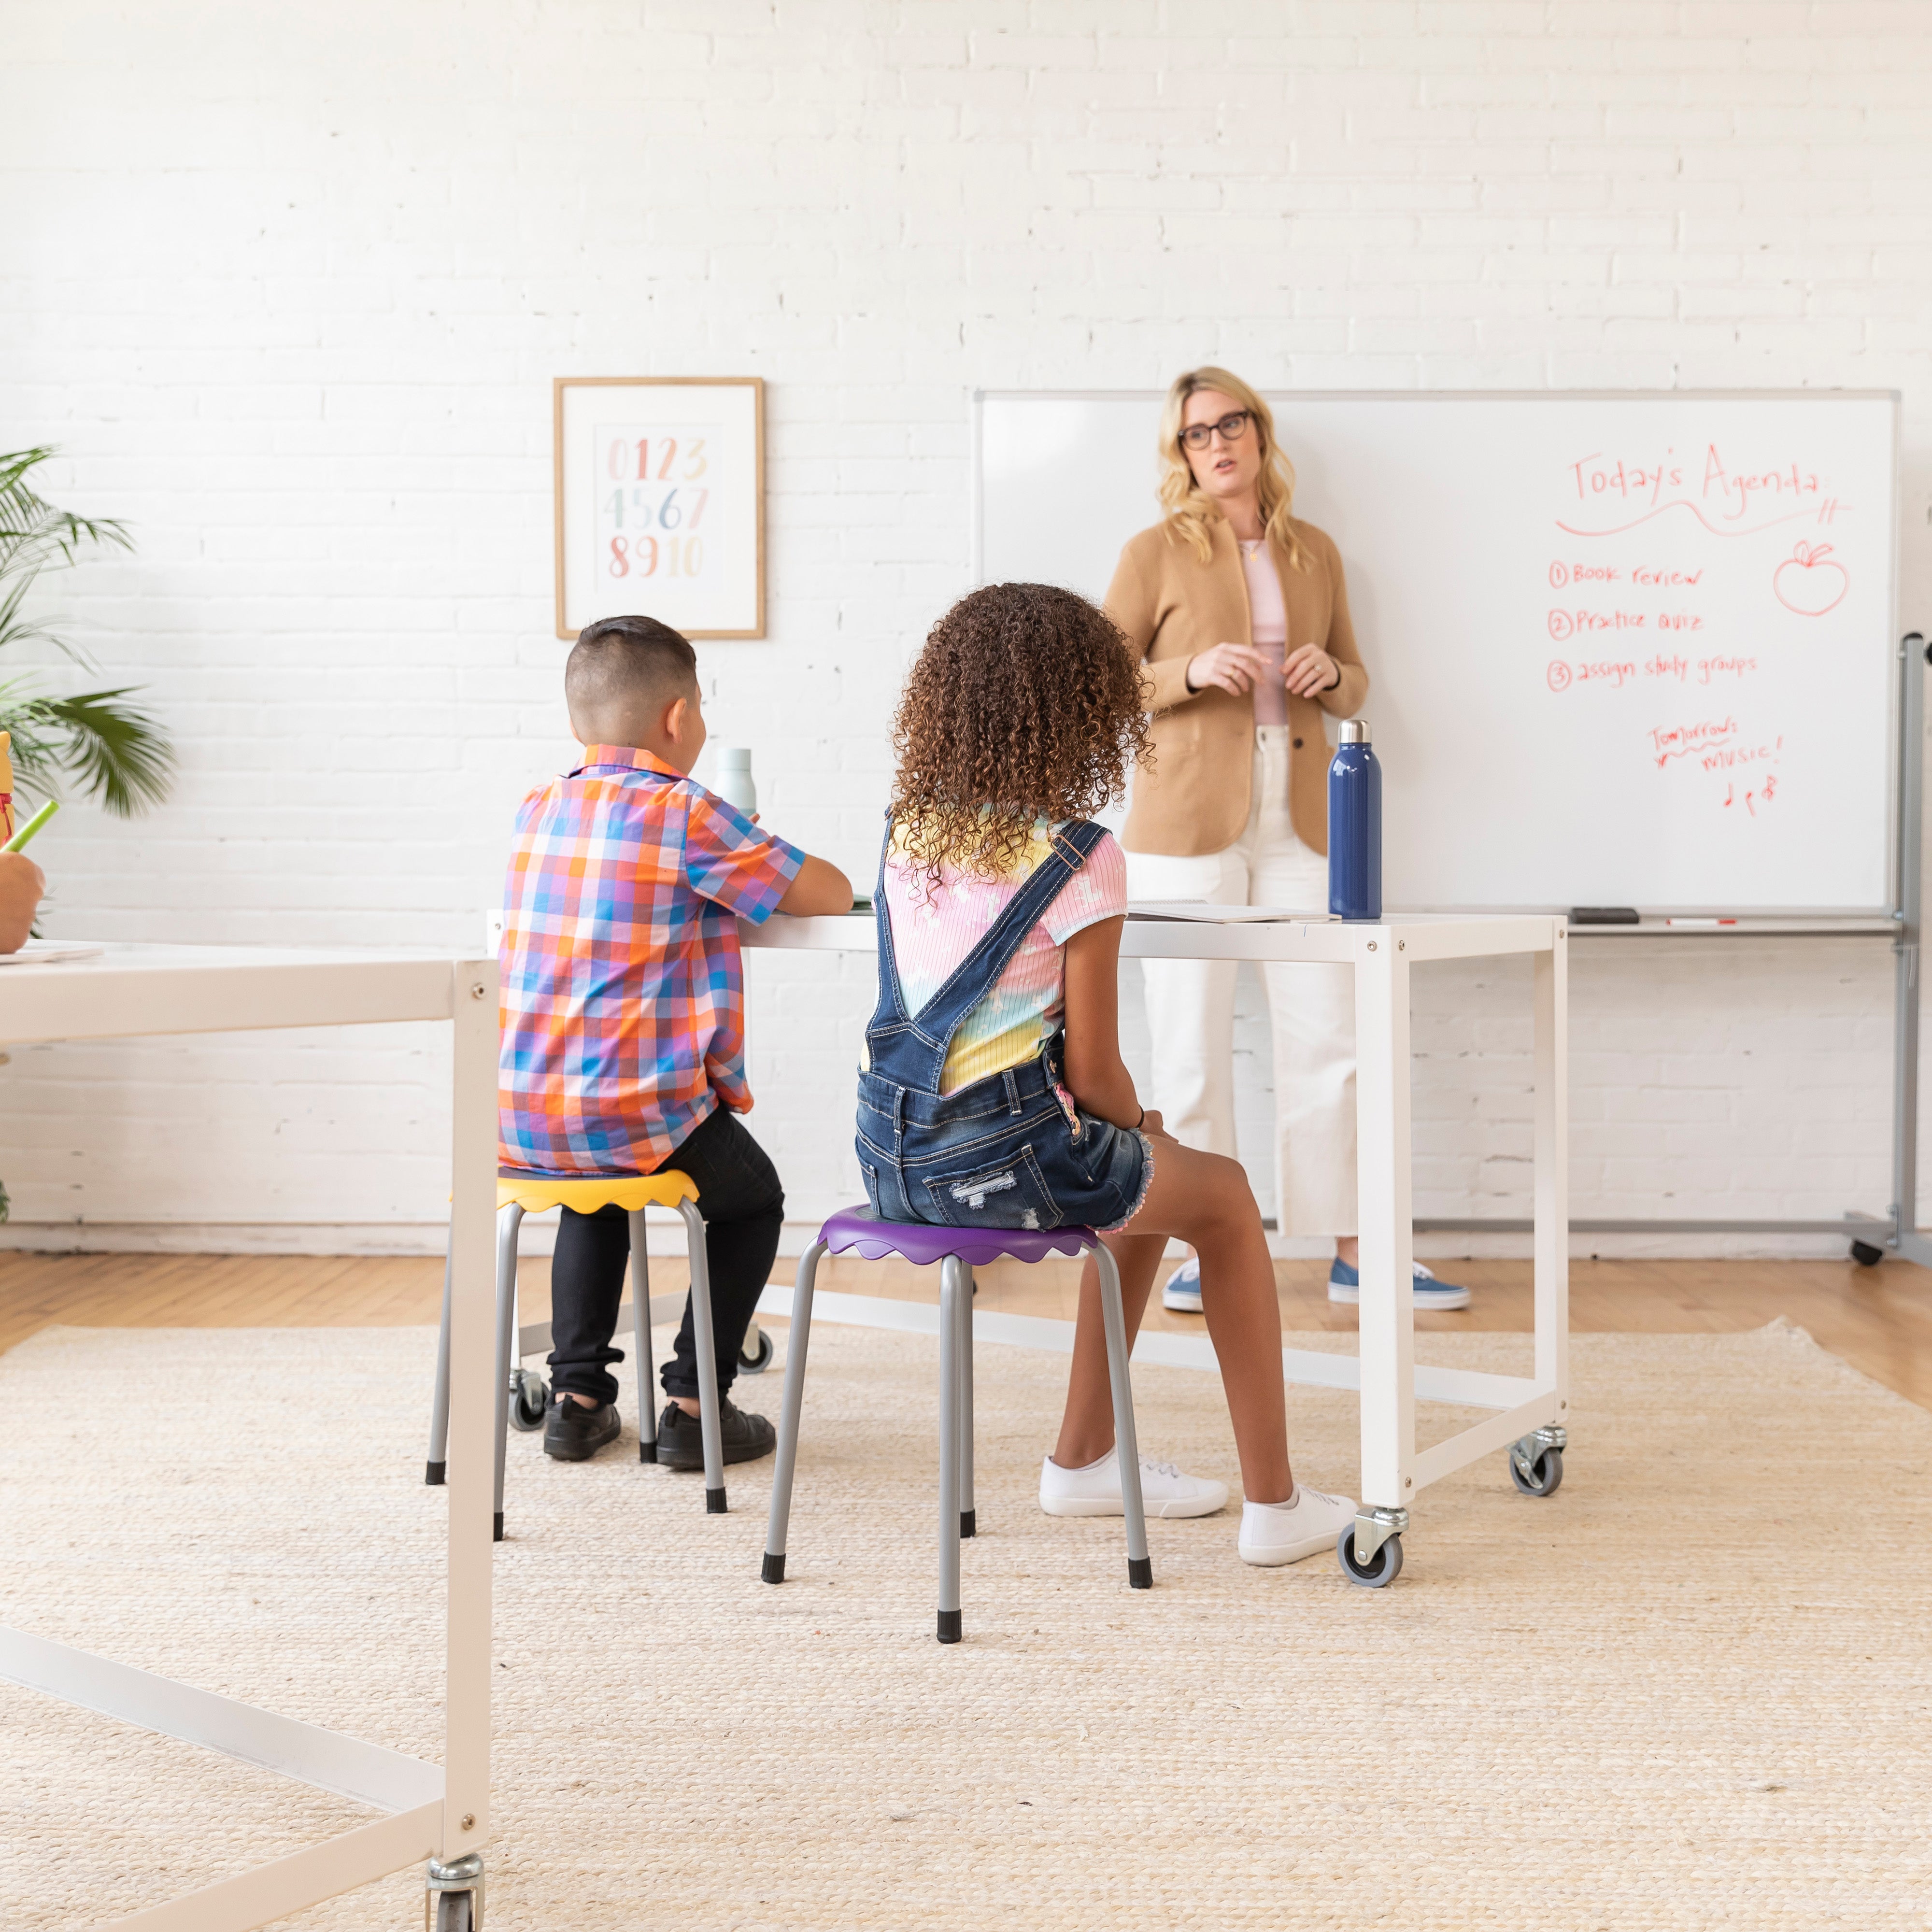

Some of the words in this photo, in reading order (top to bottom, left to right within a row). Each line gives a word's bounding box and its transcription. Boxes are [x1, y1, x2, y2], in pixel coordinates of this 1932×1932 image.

[1568, 447, 1683, 506] Today's
[1574, 564, 1620, 583] Book
[1632, 565, 1704, 586] review
[1577, 610, 1645, 632] Practice
[1577, 661, 1636, 688] assign
[1644, 654, 1689, 682] study
[1697, 654, 1758, 685] groups
